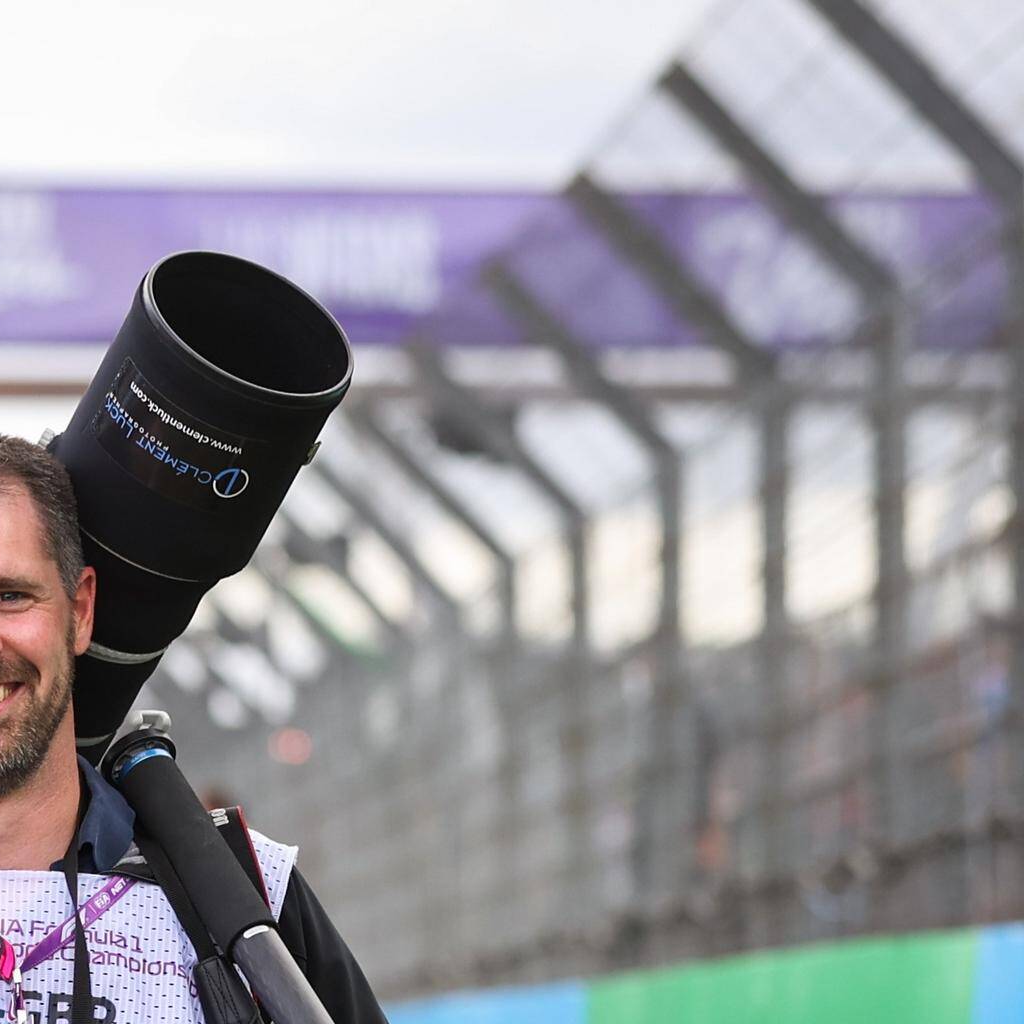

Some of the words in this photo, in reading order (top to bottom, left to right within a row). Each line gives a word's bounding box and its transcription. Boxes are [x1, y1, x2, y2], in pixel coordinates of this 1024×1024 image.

[104, 398, 134, 438] LUCK
[130, 381, 243, 455] www.clementluck.com
[135, 436, 212, 485] CLÉMENT
